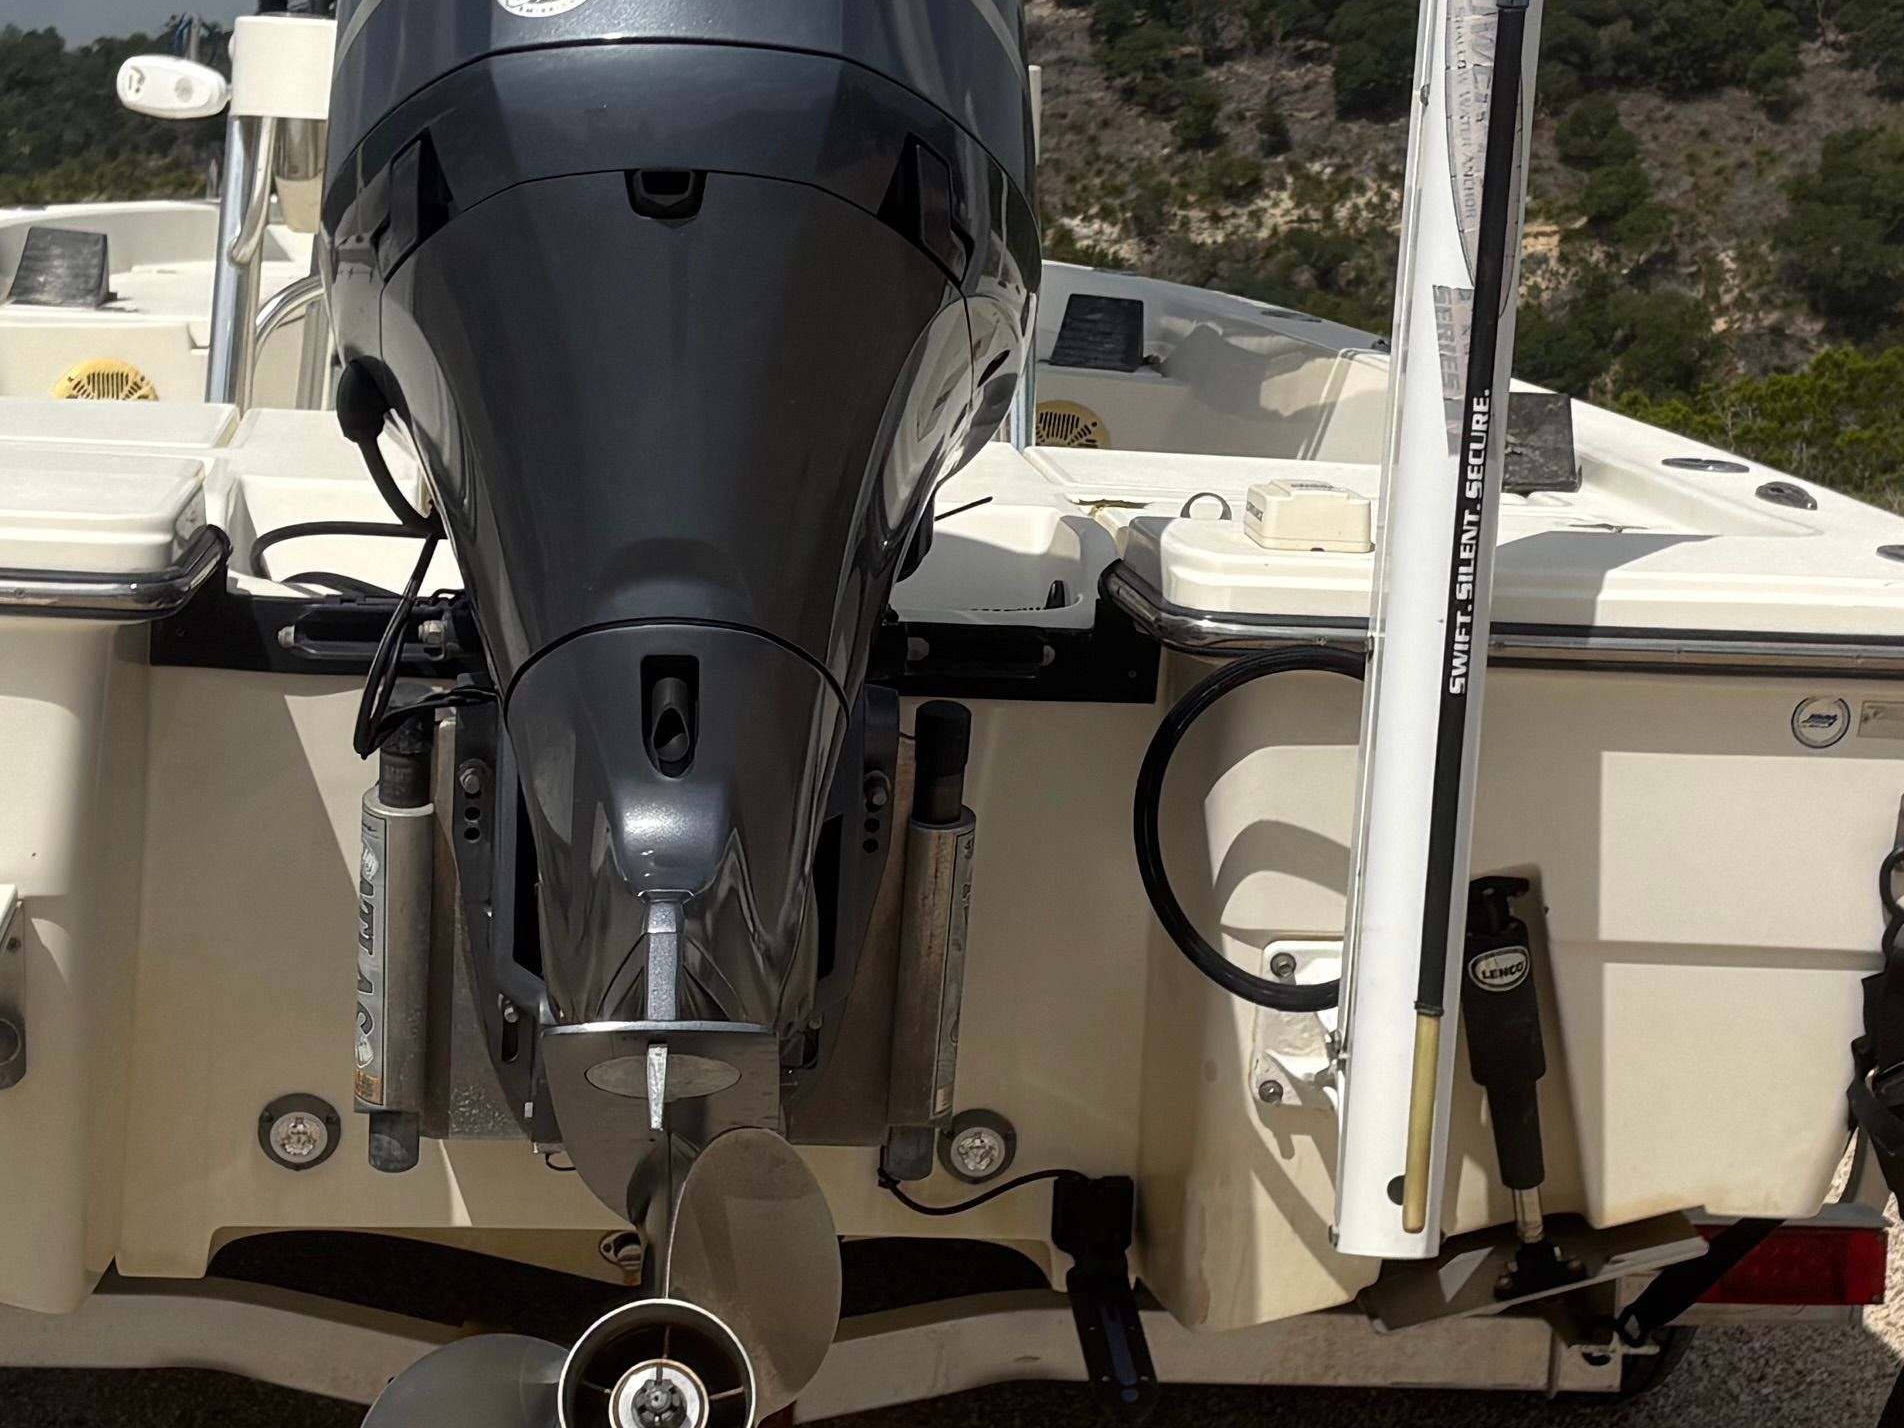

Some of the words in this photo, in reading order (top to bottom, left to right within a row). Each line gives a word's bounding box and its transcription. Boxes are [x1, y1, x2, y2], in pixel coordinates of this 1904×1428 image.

[1462, 152, 1478, 219] ANCHOR
[1464, 388, 1491, 499] SECURE.
[1455, 504, 1482, 601] SILENT.
[1449, 605, 1472, 695] SWIFT.
